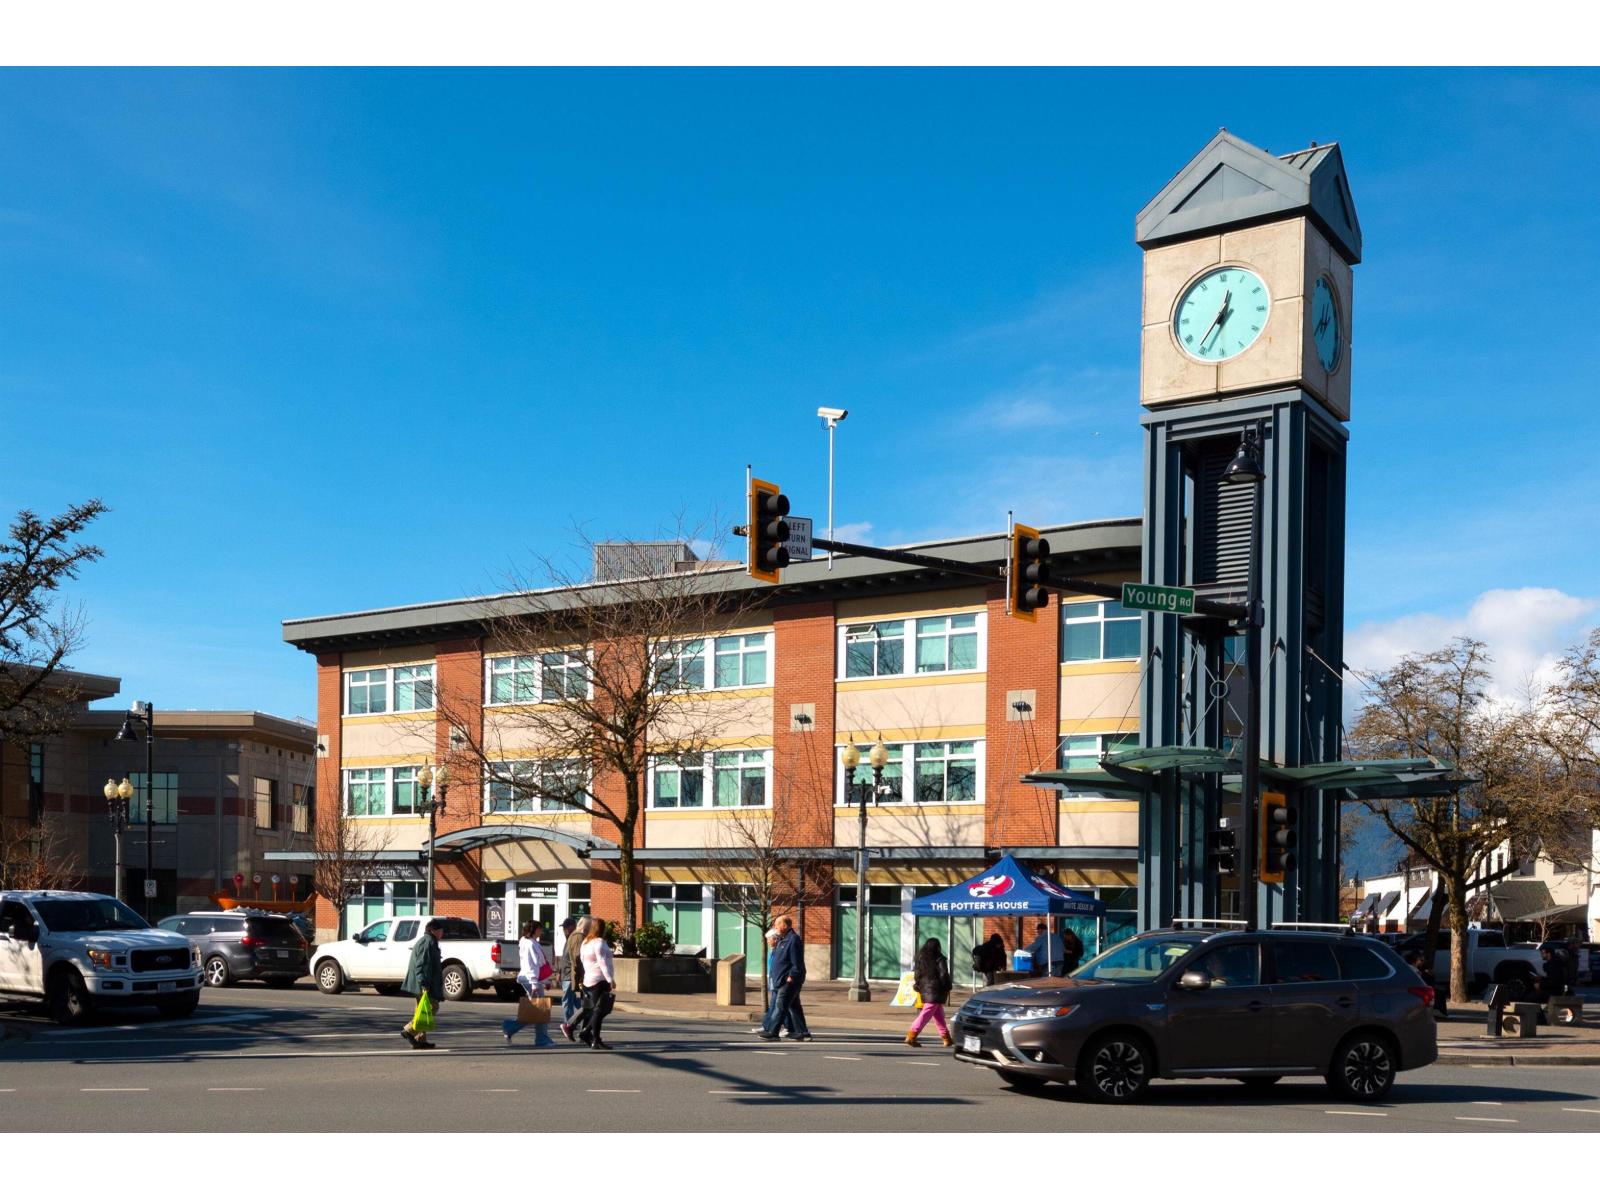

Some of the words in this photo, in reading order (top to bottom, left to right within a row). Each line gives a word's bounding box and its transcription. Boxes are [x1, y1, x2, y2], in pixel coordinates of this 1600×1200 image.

[789, 522, 805, 531] LEFT
[786, 546, 808, 555] IGNAL
[1127, 588, 1177, 610] Young
[1180, 597, 1191, 607] Rd
[931, 902, 948, 911] THE
[951, 902, 994, 911] POTTER'S
[998, 901, 1029, 910] HOUSE
